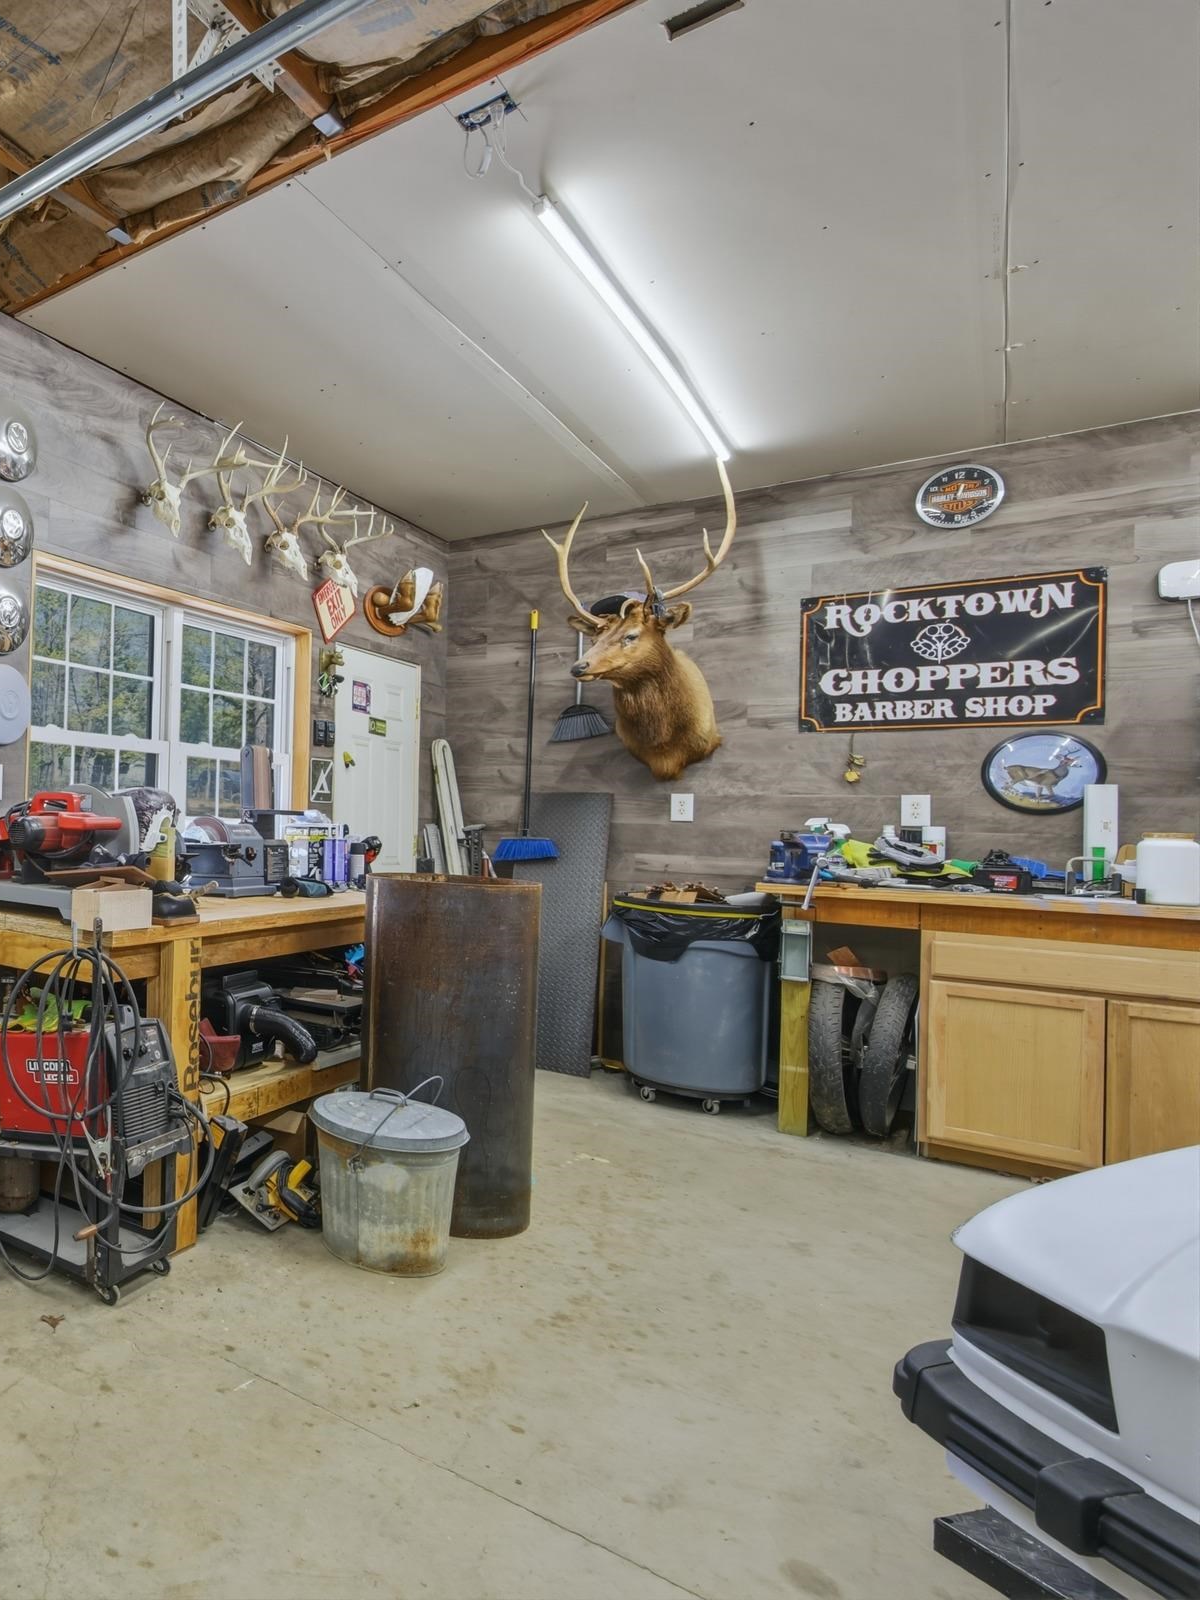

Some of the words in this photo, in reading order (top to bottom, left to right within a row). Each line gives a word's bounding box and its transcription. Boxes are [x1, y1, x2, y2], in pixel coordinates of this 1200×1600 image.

[326, 588, 343, 616] EXIT
[330, 606, 346, 630] ONLY
[824, 582, 1076, 636] ROCKTOWN
[819, 657, 1080, 696] CHOPPERS
[834, 699, 957, 722] BARBER
[965, 694, 1056, 718] SHOP
[183, 936, 200, 1093] Rosebur
